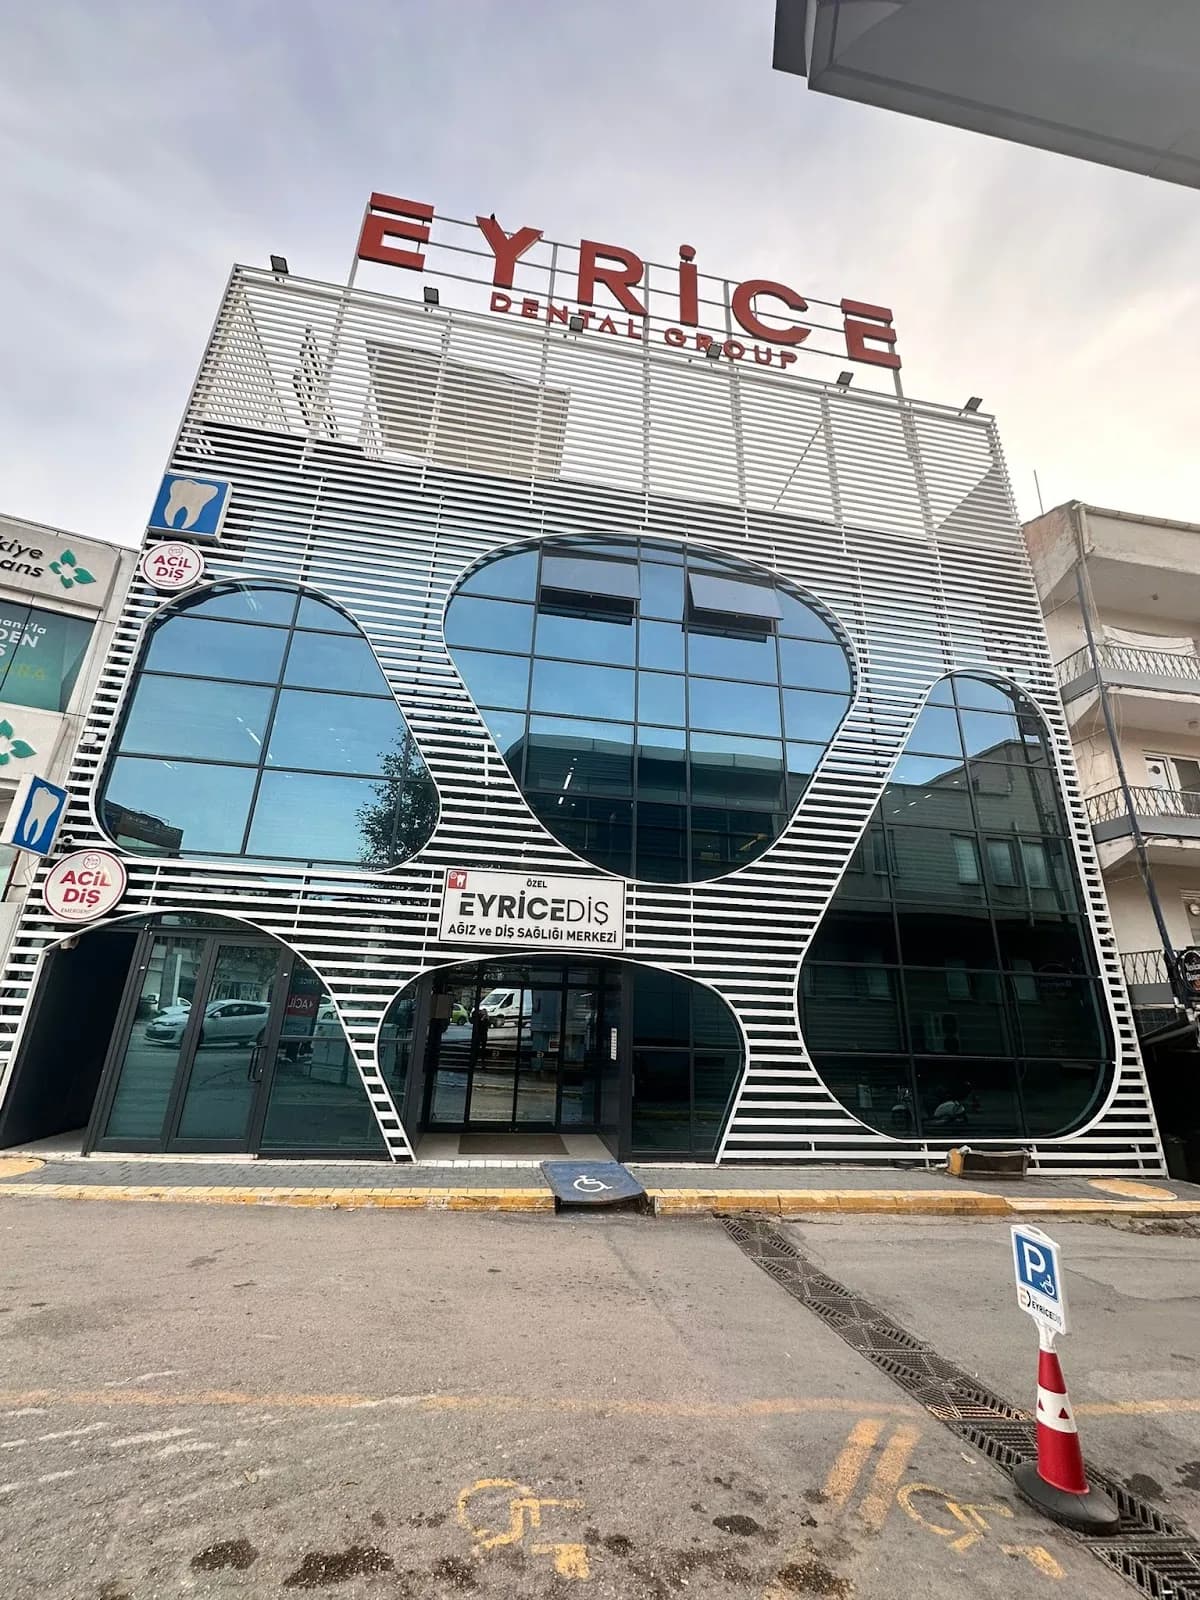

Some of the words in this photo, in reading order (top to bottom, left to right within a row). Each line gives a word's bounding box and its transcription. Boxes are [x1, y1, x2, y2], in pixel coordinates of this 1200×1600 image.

[358, 191, 902, 369] EYRİCE
[490, 291, 642, 340] DENTAL
[664, 327, 798, 369] GROUP
[526, 877, 547, 889] ÖZEL
[448, 923, 477, 937] AĞIZ
[478, 927, 492, 937] ve
[494, 924, 514, 939] DİŞ
[516, 926, 564, 941] SAĞLIĞI
[565, 930, 617, 944] MERKEZİ
[1022, 1240, 1047, 1282] P
